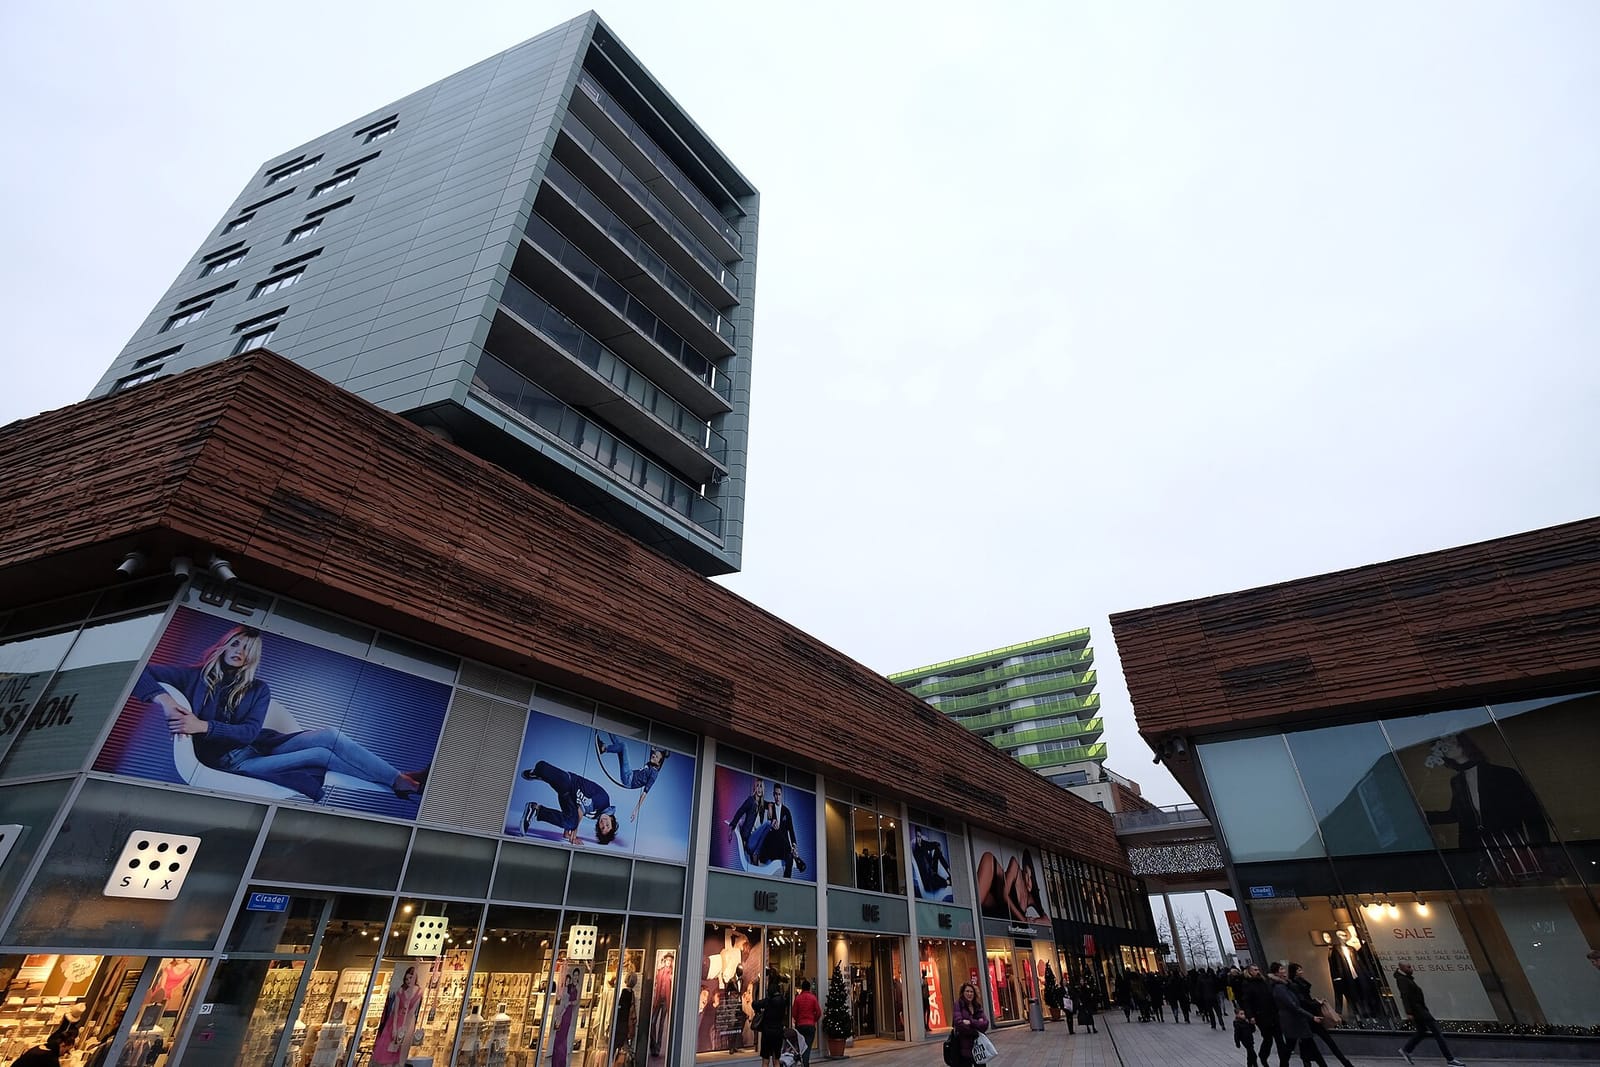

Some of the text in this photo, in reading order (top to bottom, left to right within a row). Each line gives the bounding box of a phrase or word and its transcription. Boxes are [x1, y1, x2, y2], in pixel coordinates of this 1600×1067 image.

[119, 876, 172, 890] SIX
[255, 894, 285, 904] Citadel
[754, 890, 778, 913] WE
[862, 903, 880, 922] WE
[1393, 927, 1435, 939] SALE
[413, 943, 438, 951] SIX
[1428, 963, 1455, 972] SALE
[922, 963, 941, 1025] SALE
